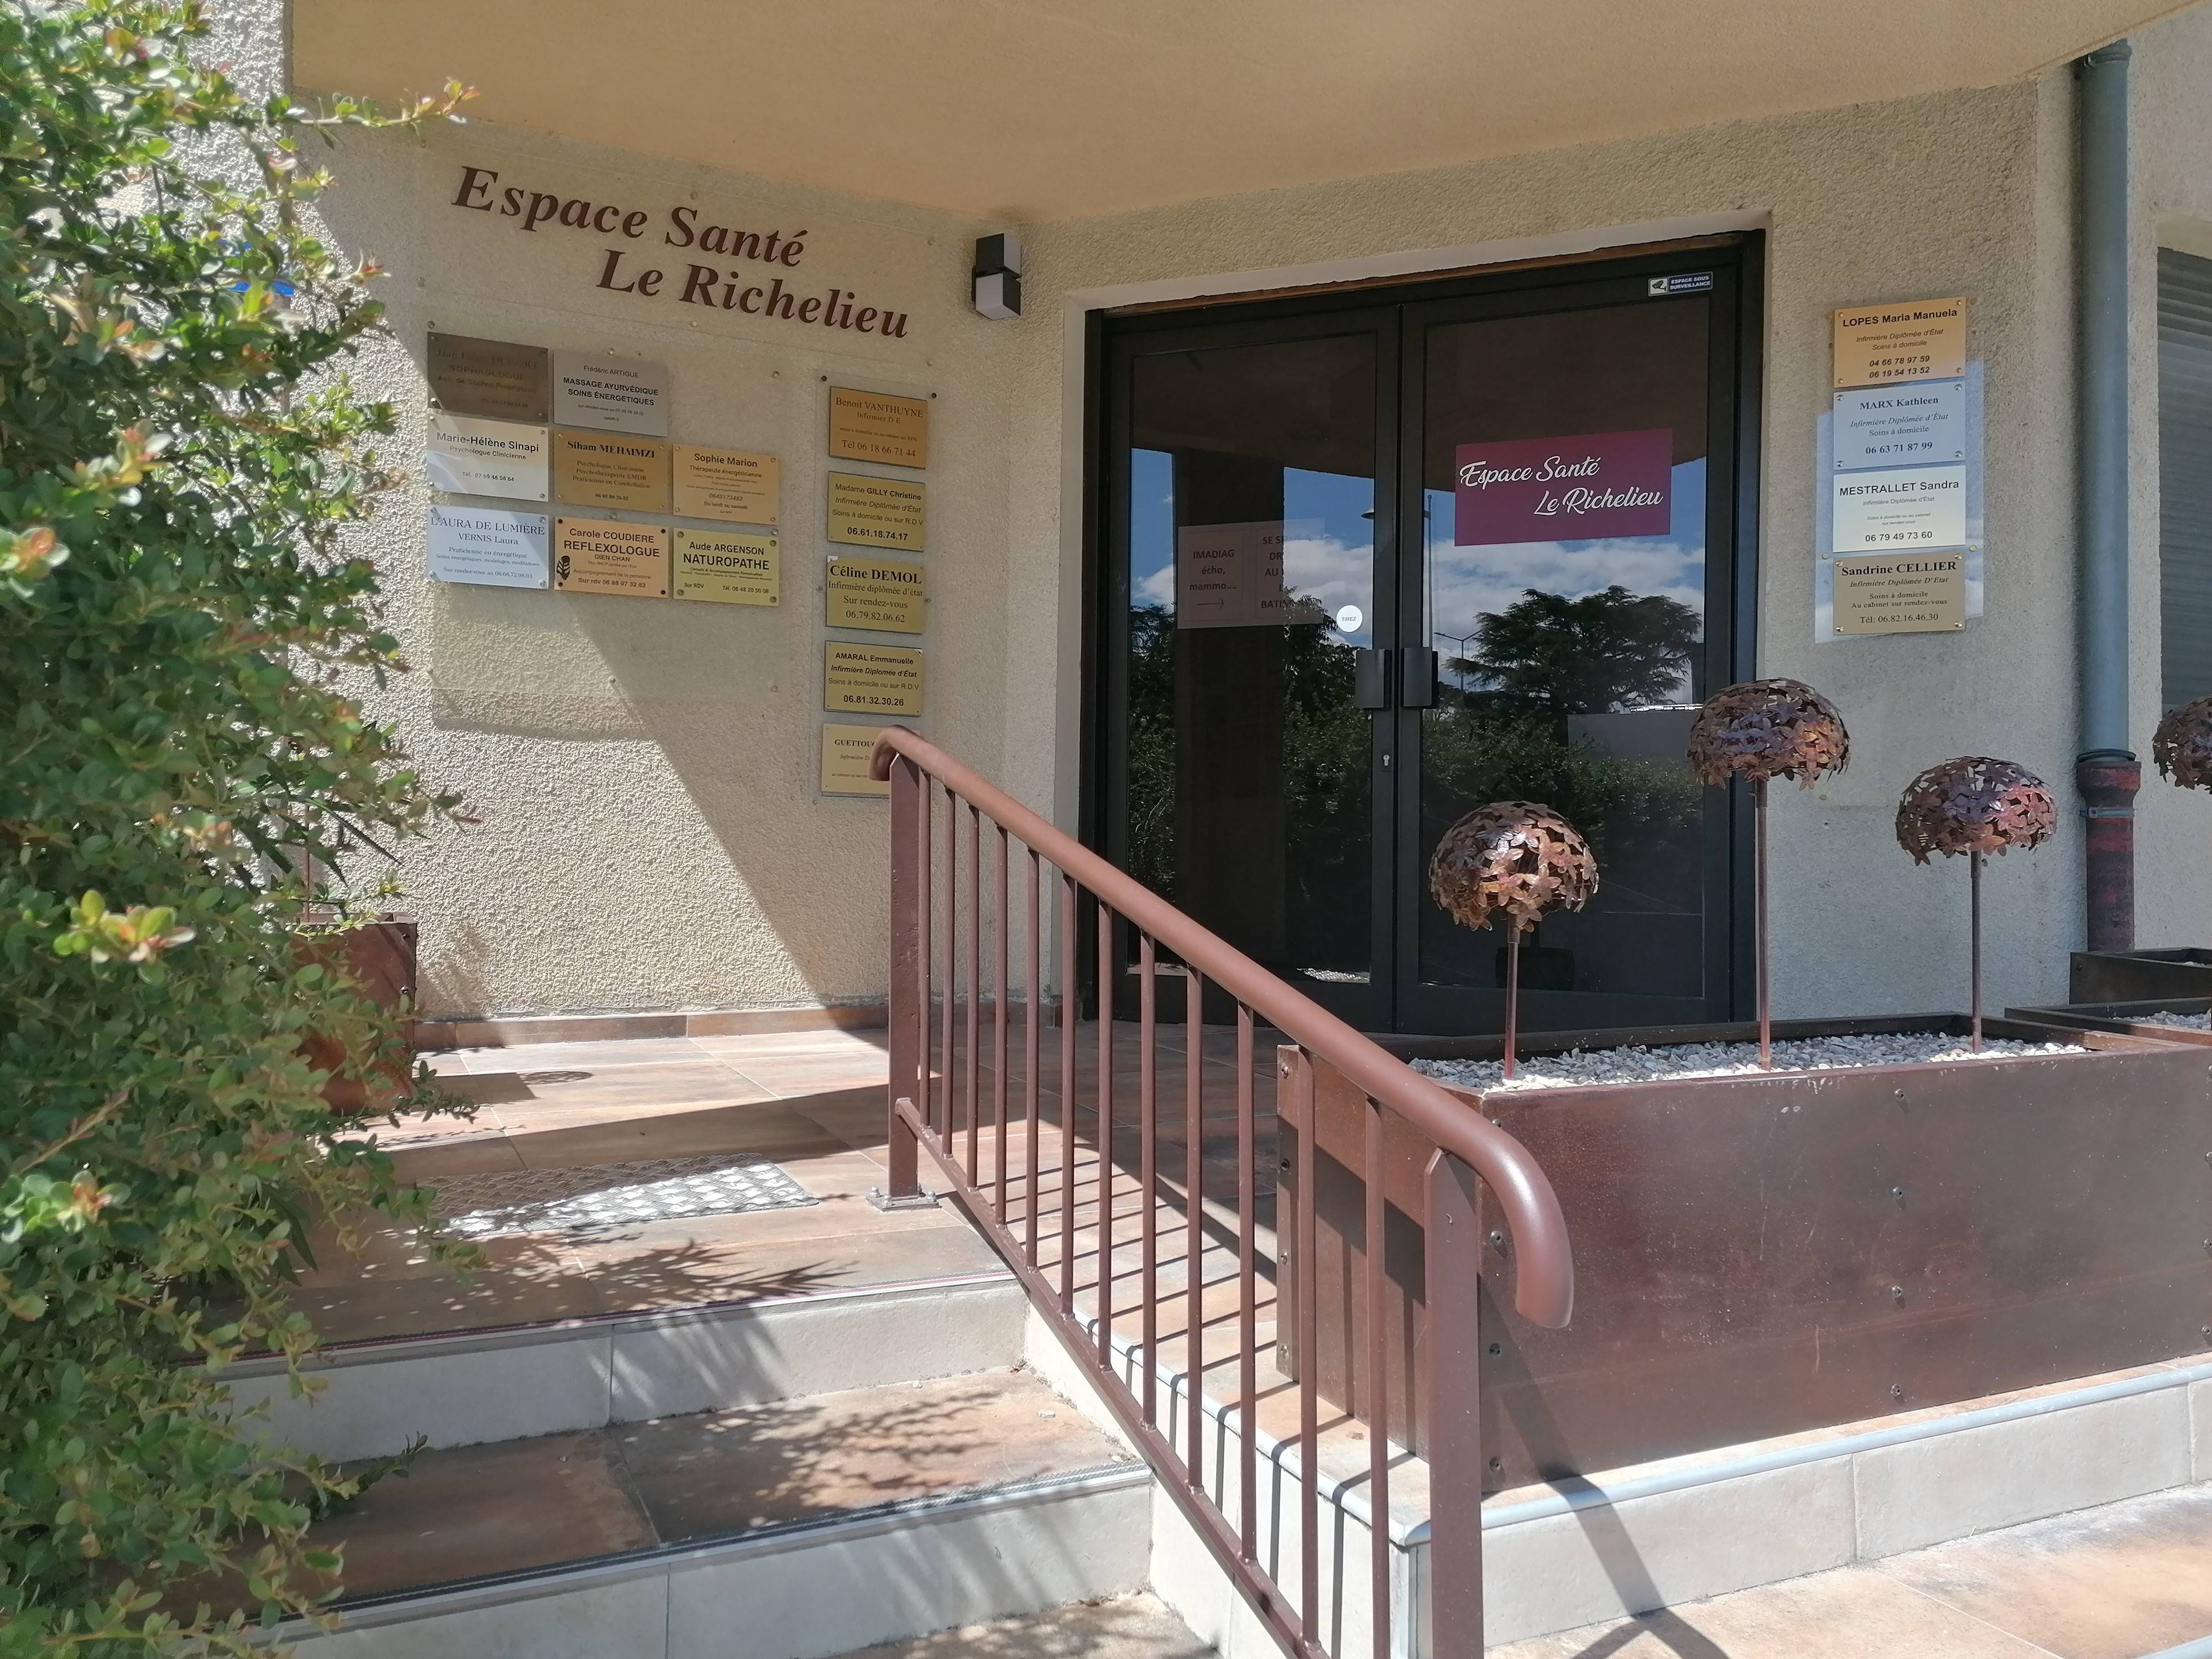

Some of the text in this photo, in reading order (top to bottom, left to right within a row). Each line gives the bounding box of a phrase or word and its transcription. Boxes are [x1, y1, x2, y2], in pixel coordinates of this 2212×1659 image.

[451, 165, 808, 267] Espace Santé
[1670, 281, 1710, 289] SURVEILLANCE
[596, 249, 908, 338] Le Richelieu
[1843, 309, 1957, 327] LOPES Maria Manuela
[583, 366, 639, 378] Frédéric ARTIGUE
[563, 377, 659, 395] MASSAGE AYURVÉDIQUE
[568, 389, 592, 398] SOINS
[865, 401, 924, 418] VANTHUYNE
[1860, 397, 1938, 410] MARX Kathleen
[1888, 416, 1923, 425] Diplômée
[1926, 413, 1949, 421] d'État
[1897, 426, 1929, 434] domicile
[437, 432, 506, 448] Marie-Hélène
[450, 446, 526, 460] Psychologue Clinicienne
[567, 441, 655, 458] Siham MEHAIMZI
[577, 460, 644, 473] Psychologue Clinicienne
[695, 453, 757, 467] Sophie Marion
[576, 468, 625, 479] Psychothérapeute
[690, 465, 761, 478] Thérapeute énergéticienne
[1459, 455, 1601, 490] Espace Santé
[614, 481, 650, 489] Constellation
[836, 483, 921, 500] Madame GILLY Christine
[1840, 481, 1959, 496] MESTRALLET Sandra
[836, 497, 866, 507] Infirmière
[869, 501, 900, 510] Diplômée
[1533, 486, 1663, 516] Le Richelieu
[431, 517, 545, 535] L'AURA DE LUMIÈRE
[458, 533, 492, 542] VERNIS
[570, 528, 654, 543] Carole COUDIERE
[847, 527, 908, 540] 06.61.18.74.17
[1262, 536, 1273, 544] SE
[564, 540, 660, 557] REFLEXOLOGUE
[690, 542, 764, 555] Aude ARGENSON
[1193, 550, 1234, 559] IMADIAG
[684, 554, 769, 570] NATUROPATHE
[1841, 561, 1957, 576] Sandrine CELLIER
[830, 565, 921, 584] Céline DEMOL
[1201, 567, 1225, 576] écho,
[1265, 568, 1278, 576] AU
[828, 581, 923, 597] Infirmière diplômée d'état
[844, 596, 908, 608] Sur rendez-vous
[846, 610, 905, 623] 06.79.82.06.62
[1878, 613, 1938, 622] 06.82.16.46.30
[836, 653, 914, 665] AMARAL Emmanuelle
[844, 695, 903, 706] 06.81.32.30.26
